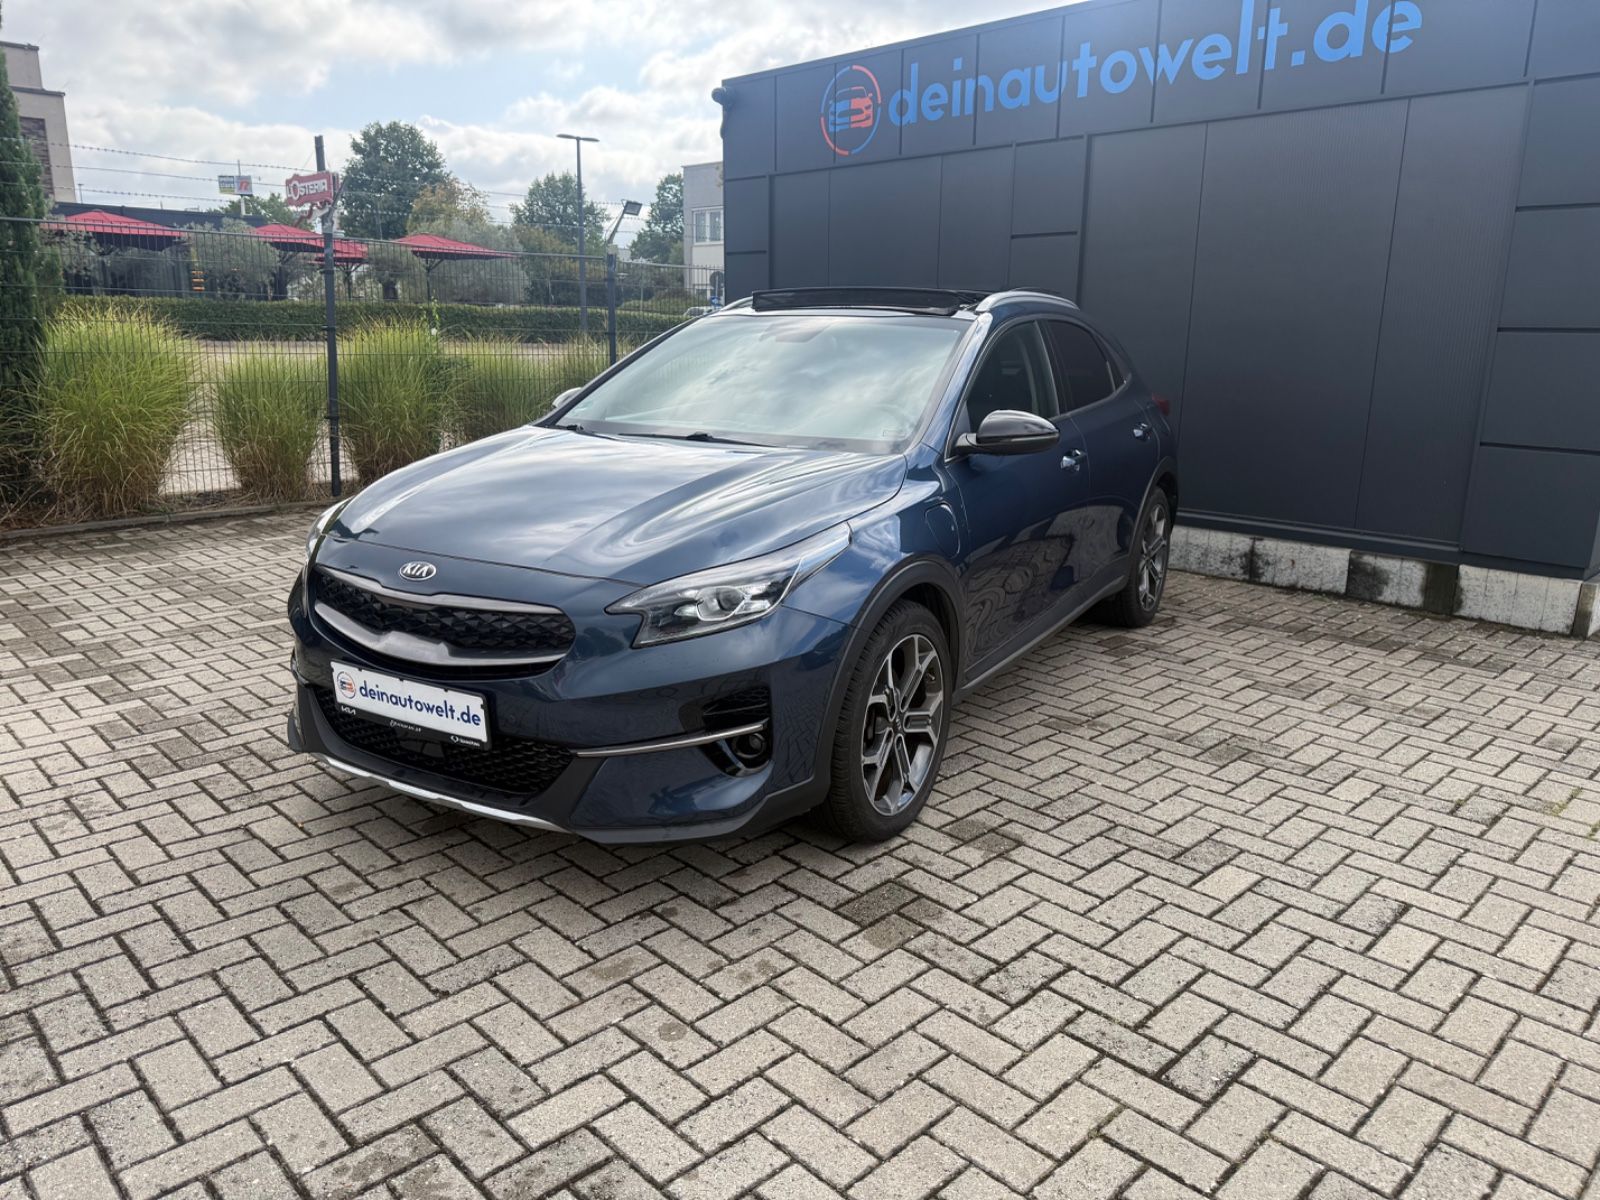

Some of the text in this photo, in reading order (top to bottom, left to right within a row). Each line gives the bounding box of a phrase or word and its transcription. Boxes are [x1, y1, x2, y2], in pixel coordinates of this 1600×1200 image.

[888, 0, 1423, 127] deinautowelt.de
[402, 563, 430, 577] KIA
[359, 680, 481, 726] deinautowelt.de
